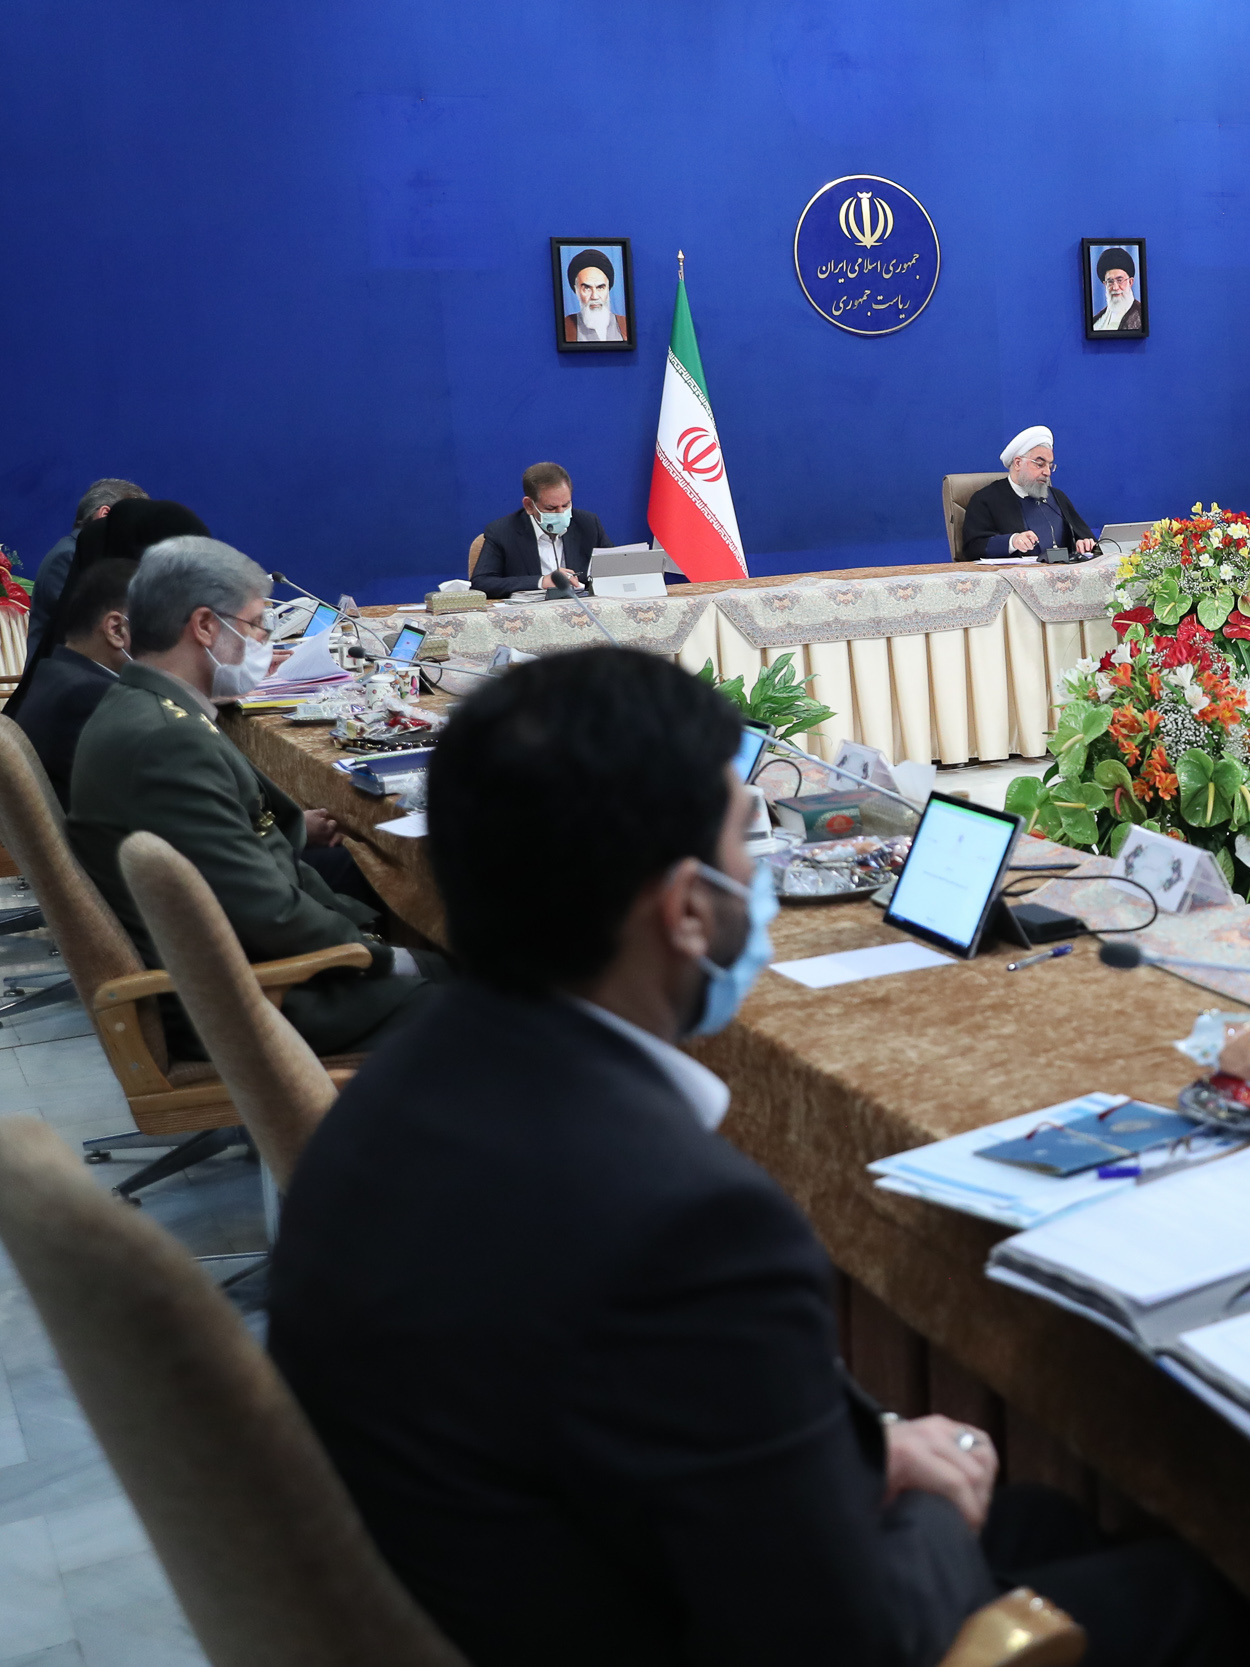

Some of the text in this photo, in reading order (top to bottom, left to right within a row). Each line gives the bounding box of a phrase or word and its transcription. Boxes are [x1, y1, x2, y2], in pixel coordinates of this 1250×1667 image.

[817, 253, 920, 283] جمهوری اسلامی ایران
[831, 289, 911, 319] ریاست جمهوری
